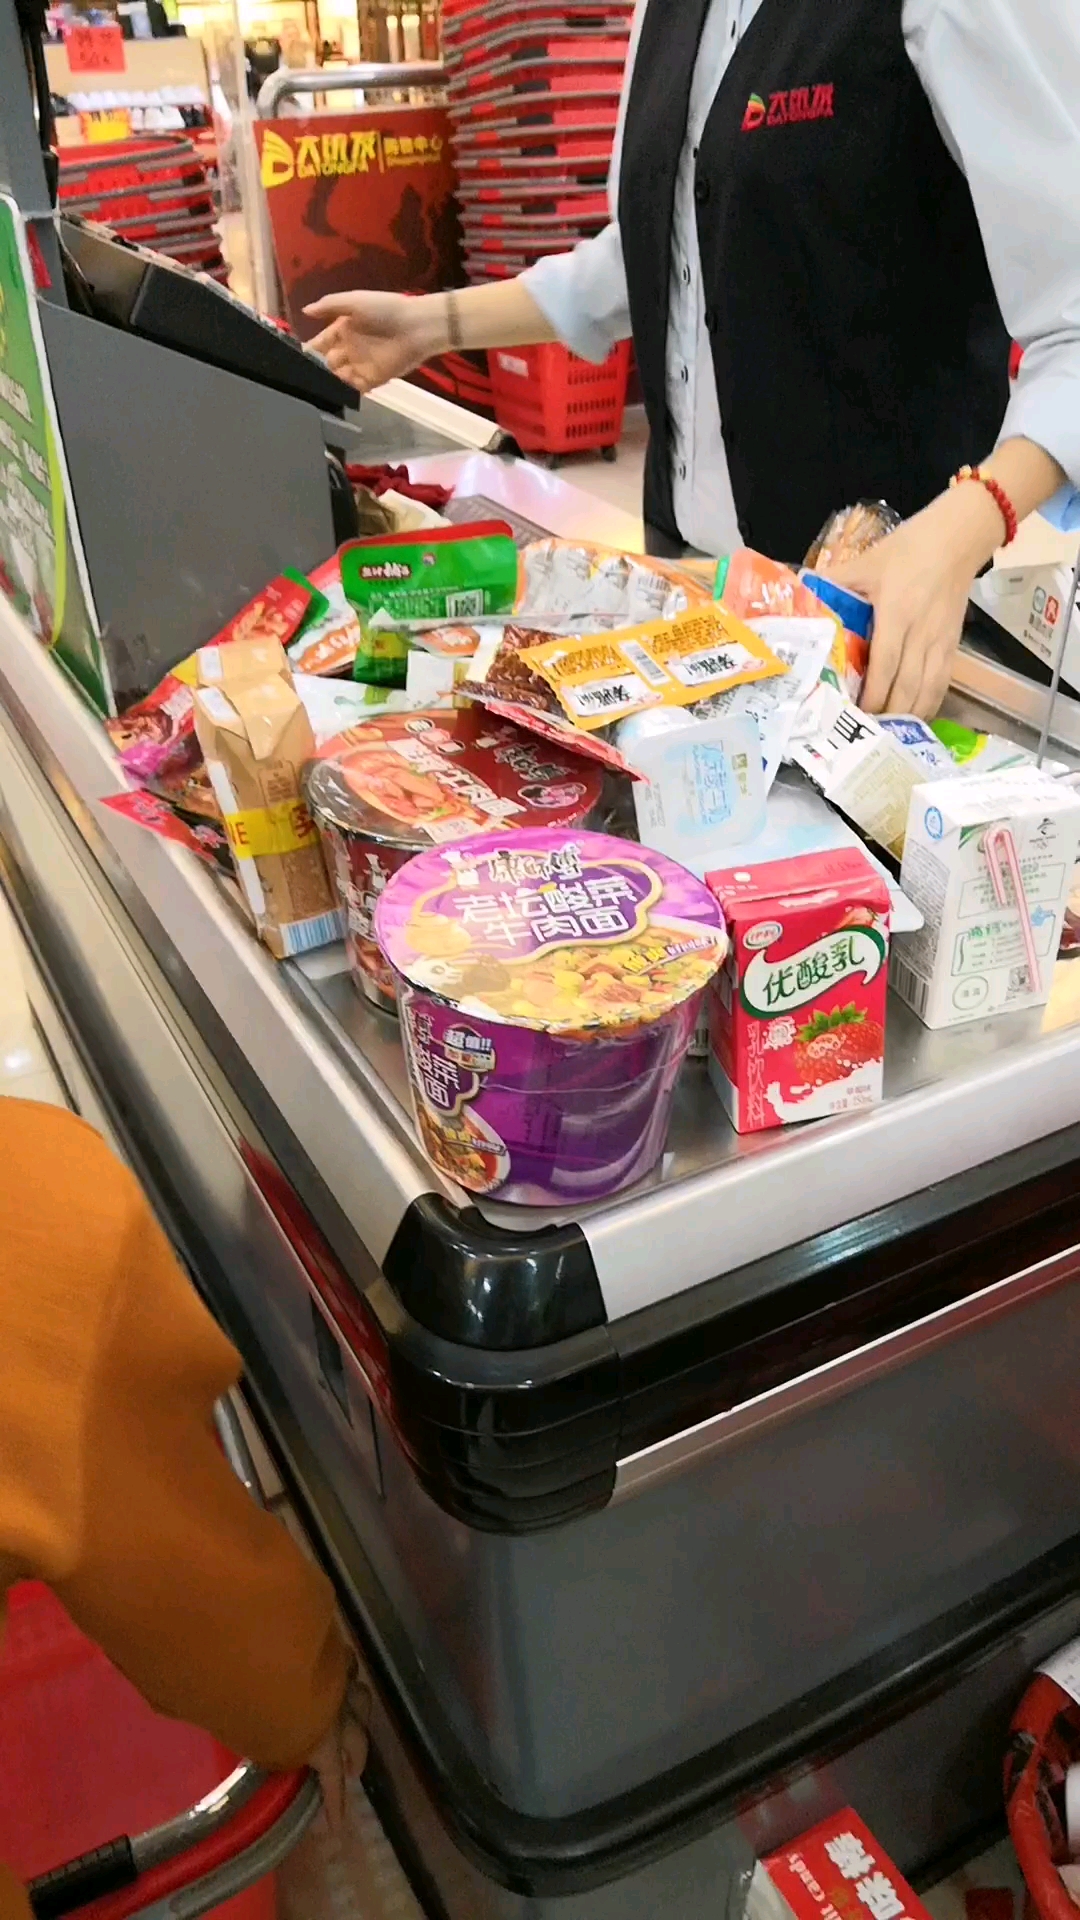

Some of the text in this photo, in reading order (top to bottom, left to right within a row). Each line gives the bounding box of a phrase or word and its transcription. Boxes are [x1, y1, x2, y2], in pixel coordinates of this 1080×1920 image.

[453, 874, 639, 925] 老坛酸菜
[482, 904, 630, 946] 牛肉面
[762, 935, 865, 1006] 优酸乳
[788, 1852, 826, 1902] candy
